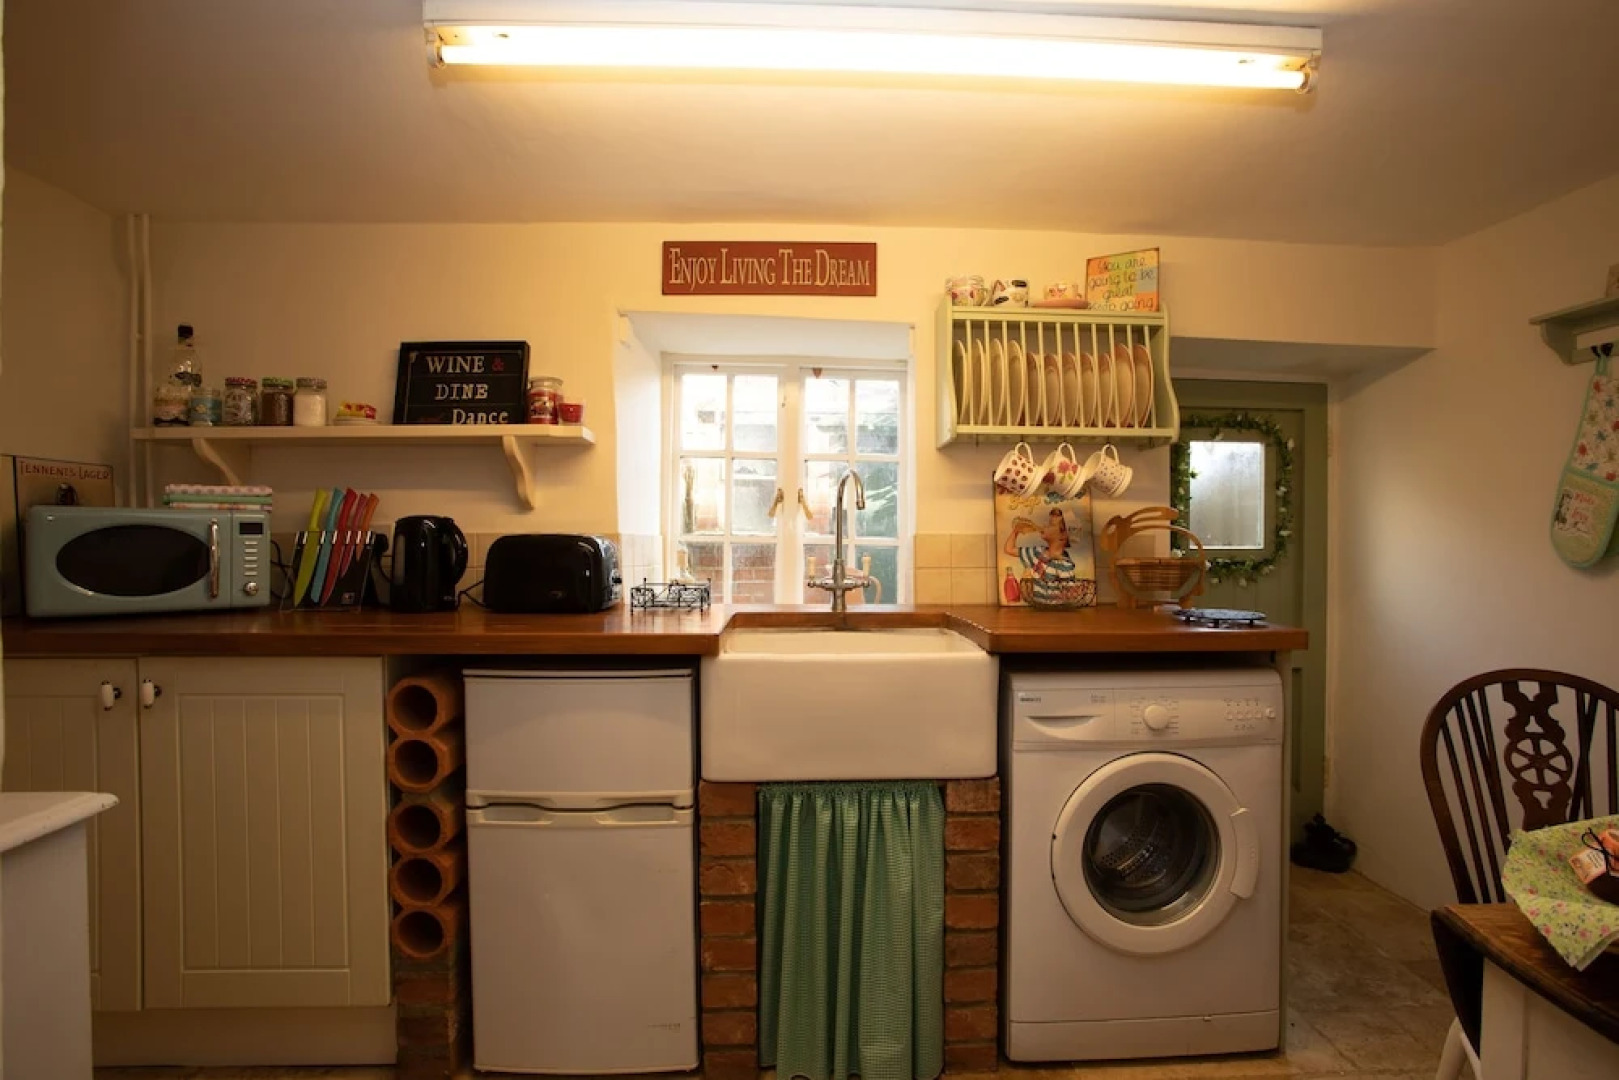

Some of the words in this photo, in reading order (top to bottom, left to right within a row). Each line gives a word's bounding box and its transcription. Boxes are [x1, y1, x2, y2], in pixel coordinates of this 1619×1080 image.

[669, 247, 717, 291] ENJOY
[720, 248, 776, 286] LIVING
[779, 249, 812, 286] THE
[814, 249, 870, 287] DREAM
[425, 355, 485, 373] WINE
[434, 383, 488, 400] DINE
[452, 409, 509, 425] Dance
